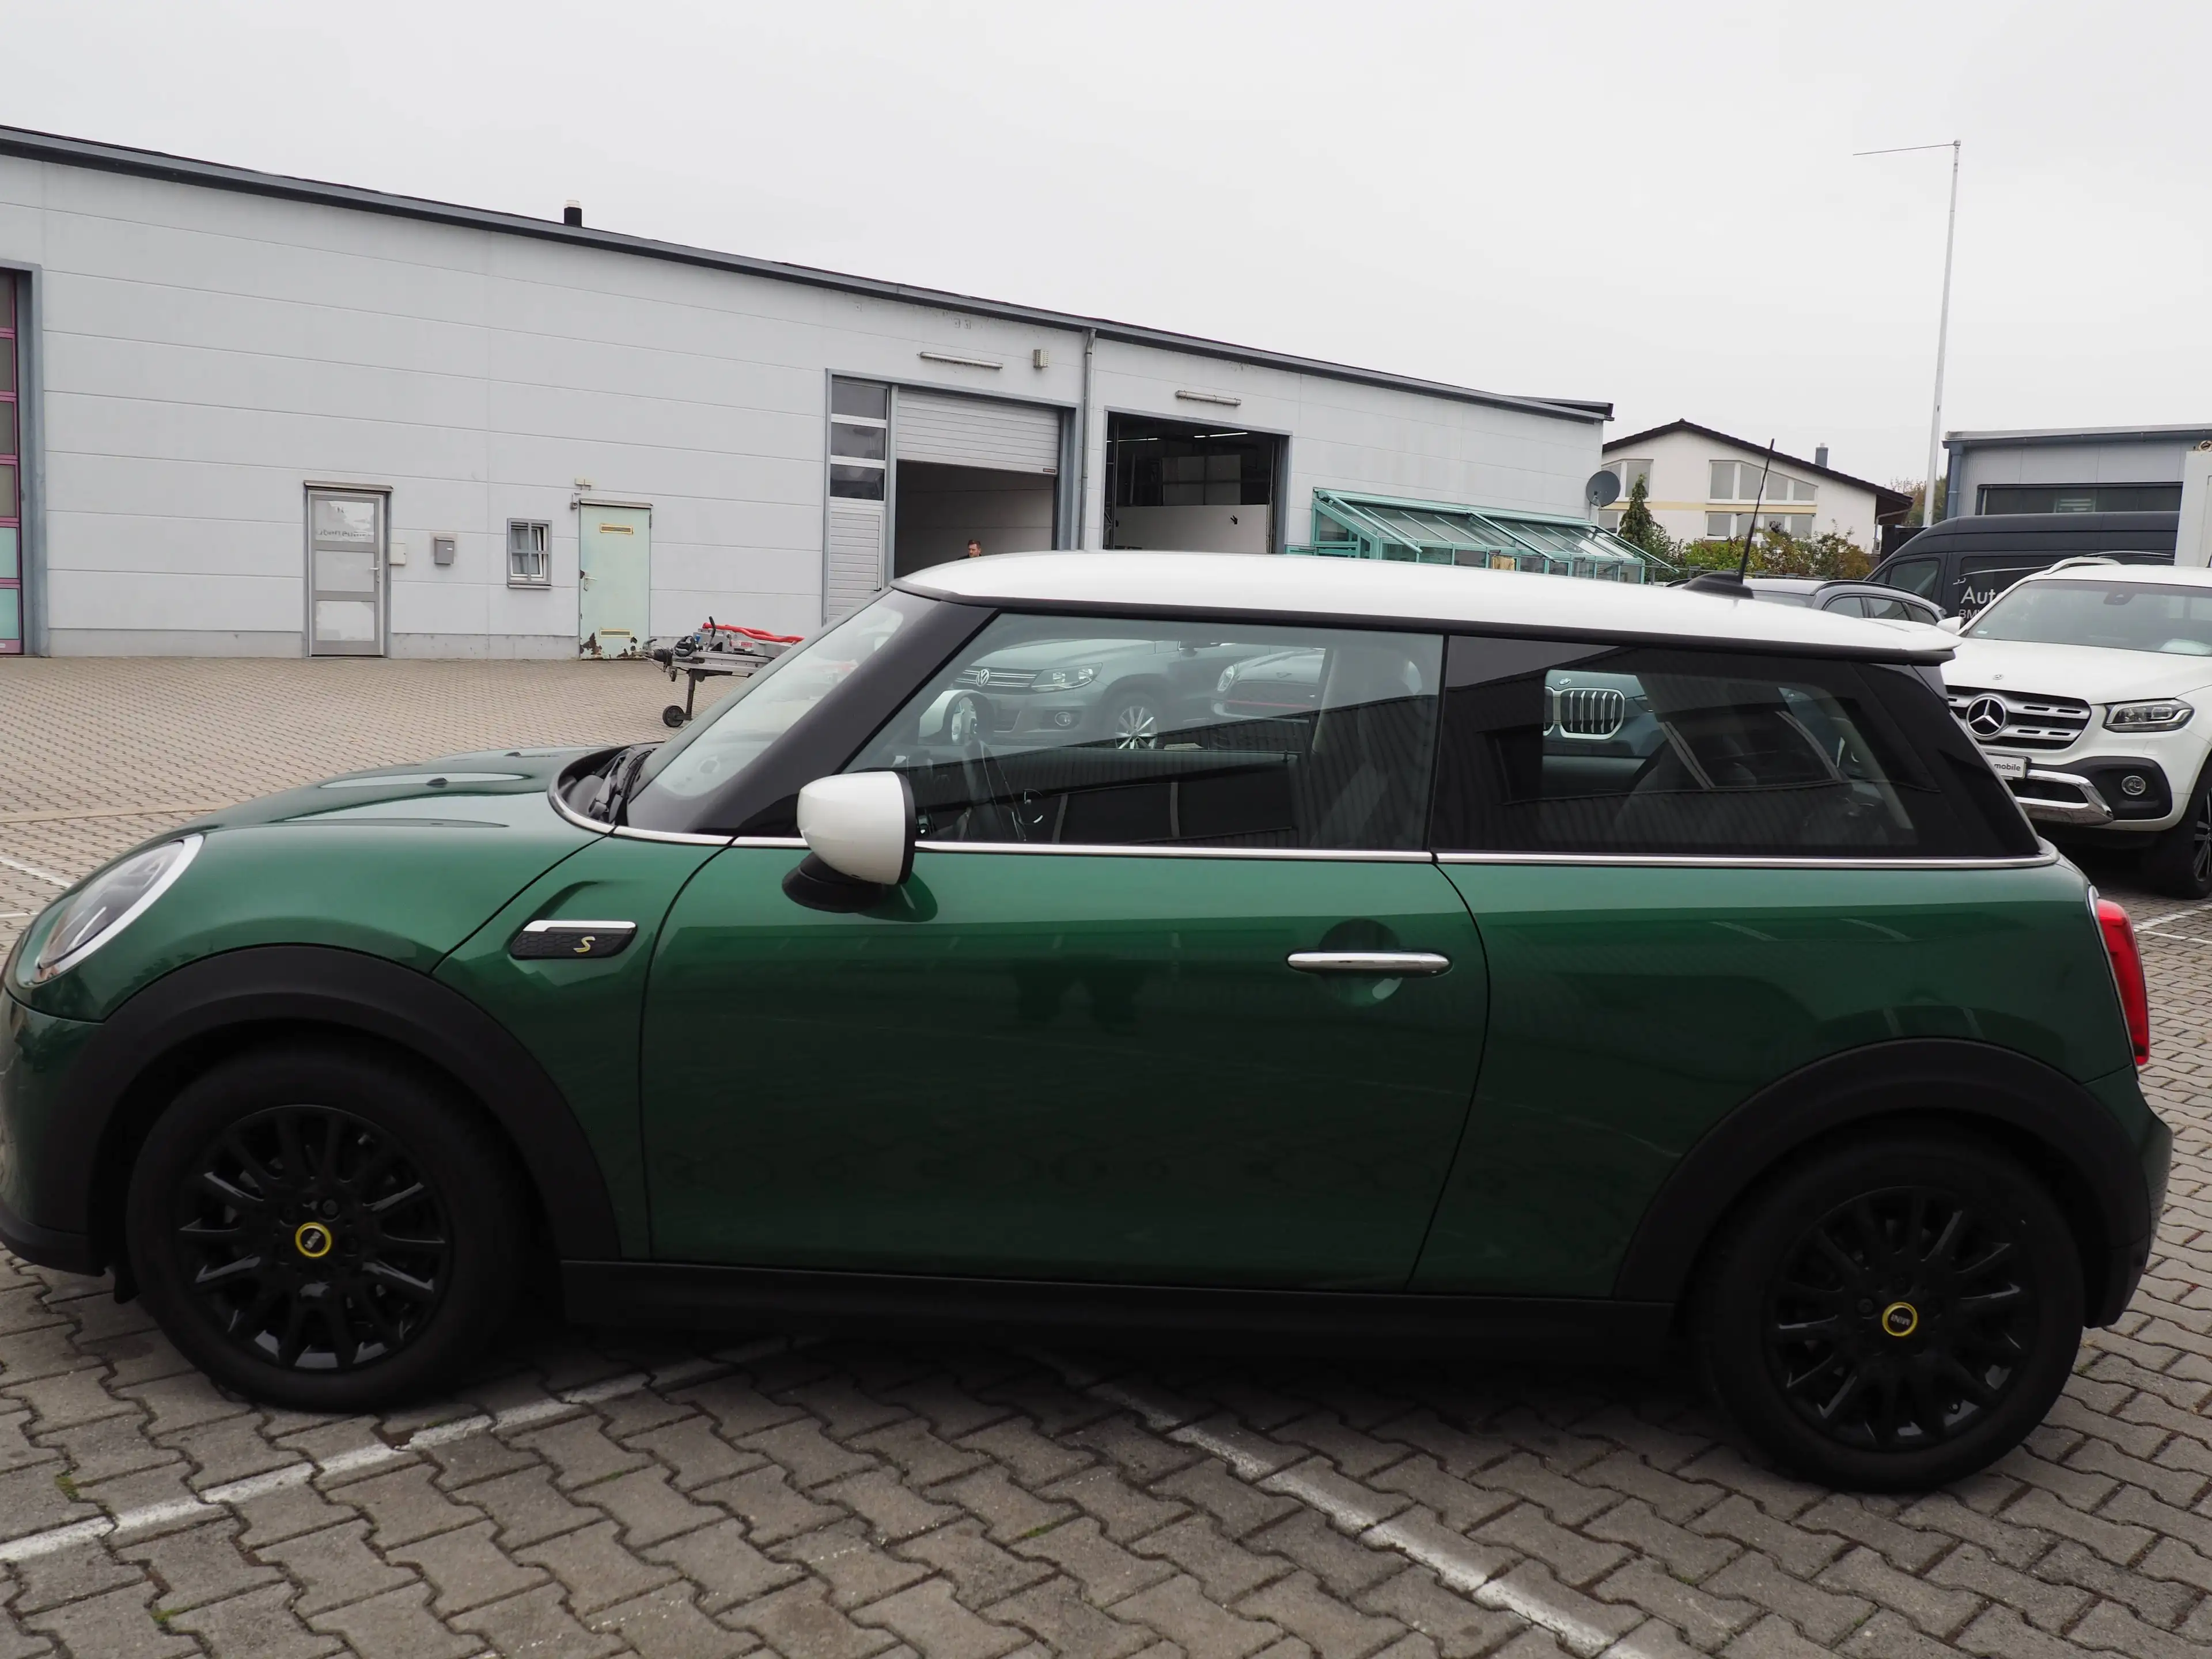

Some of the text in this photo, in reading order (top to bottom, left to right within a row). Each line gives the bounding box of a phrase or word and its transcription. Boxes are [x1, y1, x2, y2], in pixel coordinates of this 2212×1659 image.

[1960, 586, 2003, 604] Aut
[1959, 609, 1980, 619] BM
[573, 936, 596, 952] S
